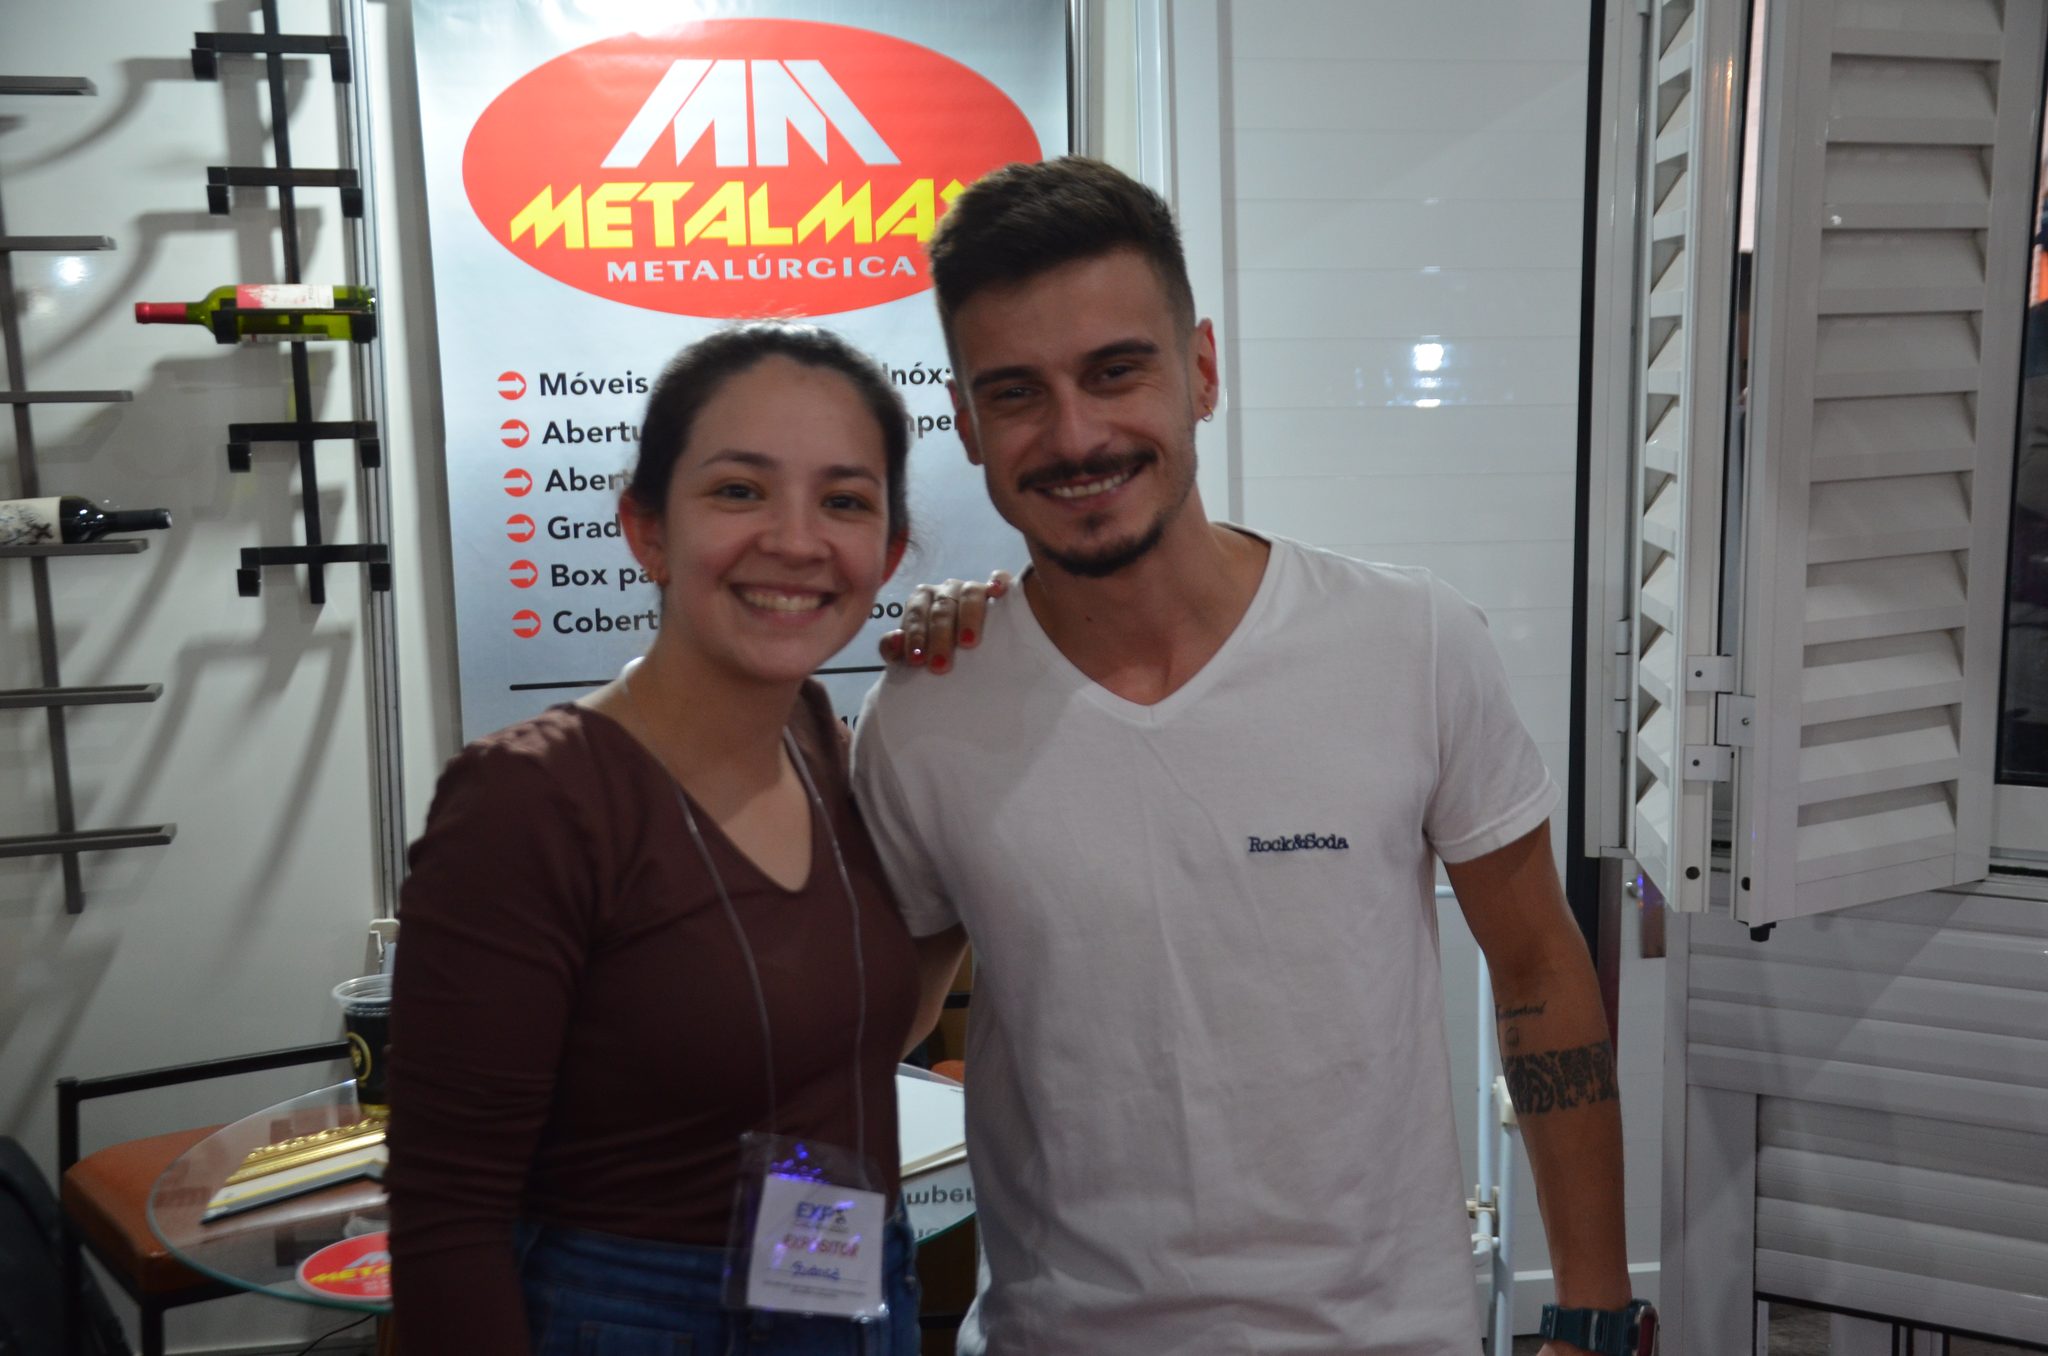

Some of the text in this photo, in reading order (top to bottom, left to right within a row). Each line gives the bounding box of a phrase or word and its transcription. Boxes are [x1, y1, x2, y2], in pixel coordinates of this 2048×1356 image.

[607, 253, 916, 283] METALÚRGICA
[539, 370, 649, 396] Móveis
[547, 512, 622, 540] Grad
[551, 564, 608, 587] Box
[553, 608, 658, 634] Cobert
[1247, 832, 1349, 853] Rock&Soda
